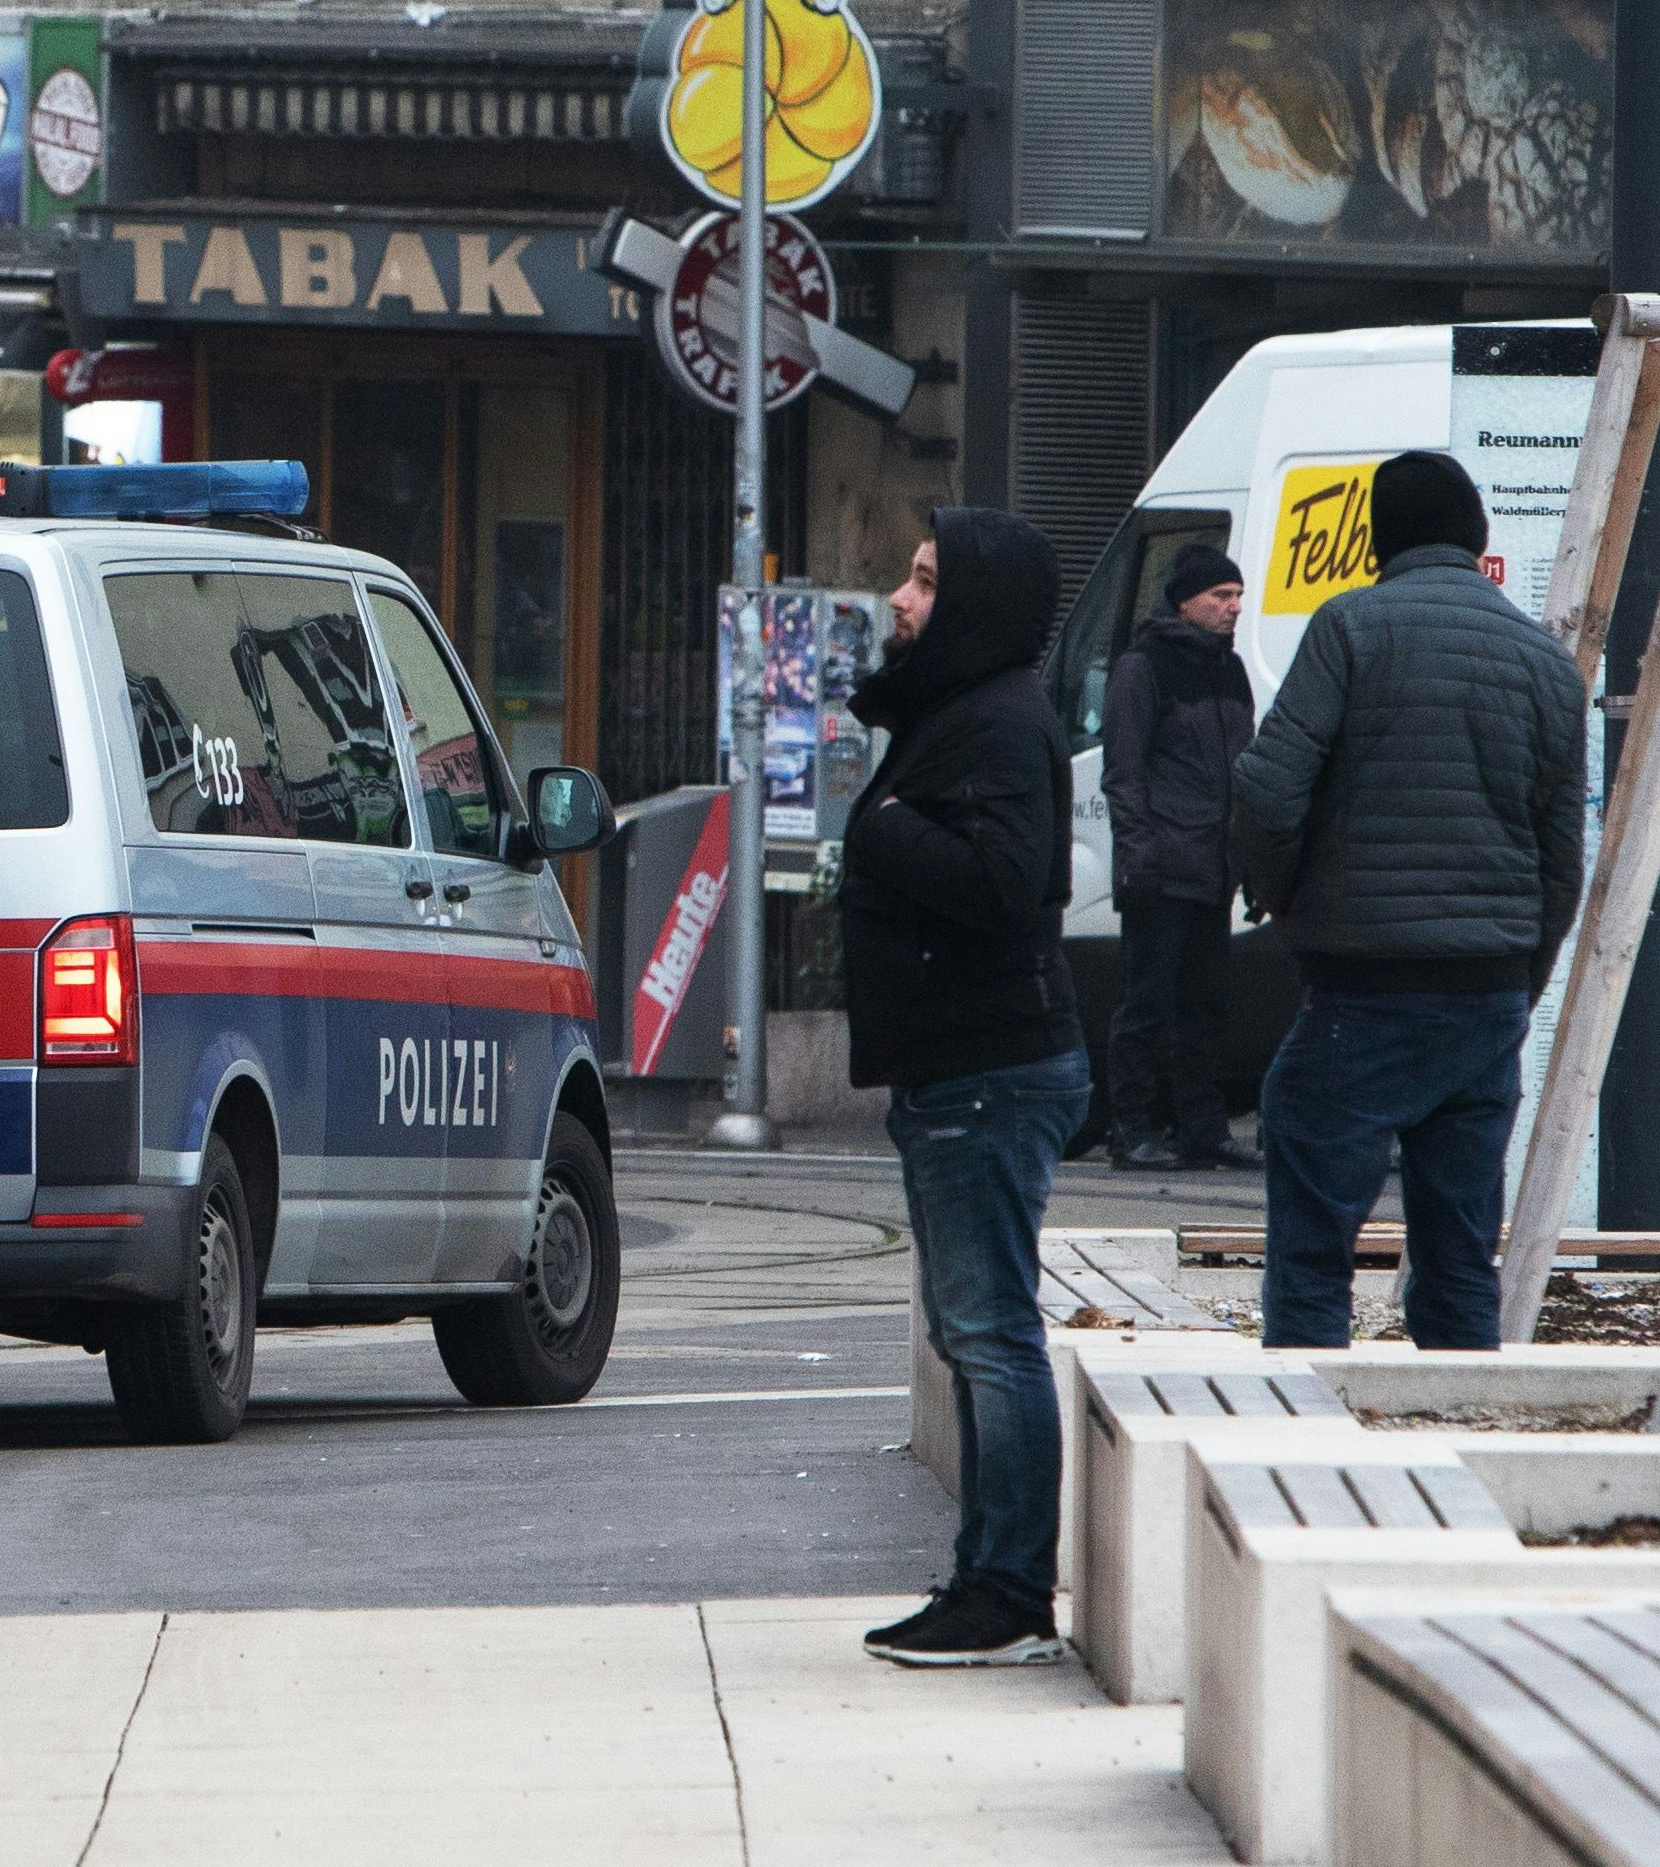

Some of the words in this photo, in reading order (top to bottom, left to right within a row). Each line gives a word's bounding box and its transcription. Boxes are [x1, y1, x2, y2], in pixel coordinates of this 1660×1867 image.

[113, 224, 544, 315] TABAK
[675, 292, 789, 398] TRAFK
[1477, 430, 1583, 448] Reumann
[206, 737, 244, 805] 133
[641, 870, 720, 1010] Heute
[378, 1036, 498, 1127] POLIZEI
